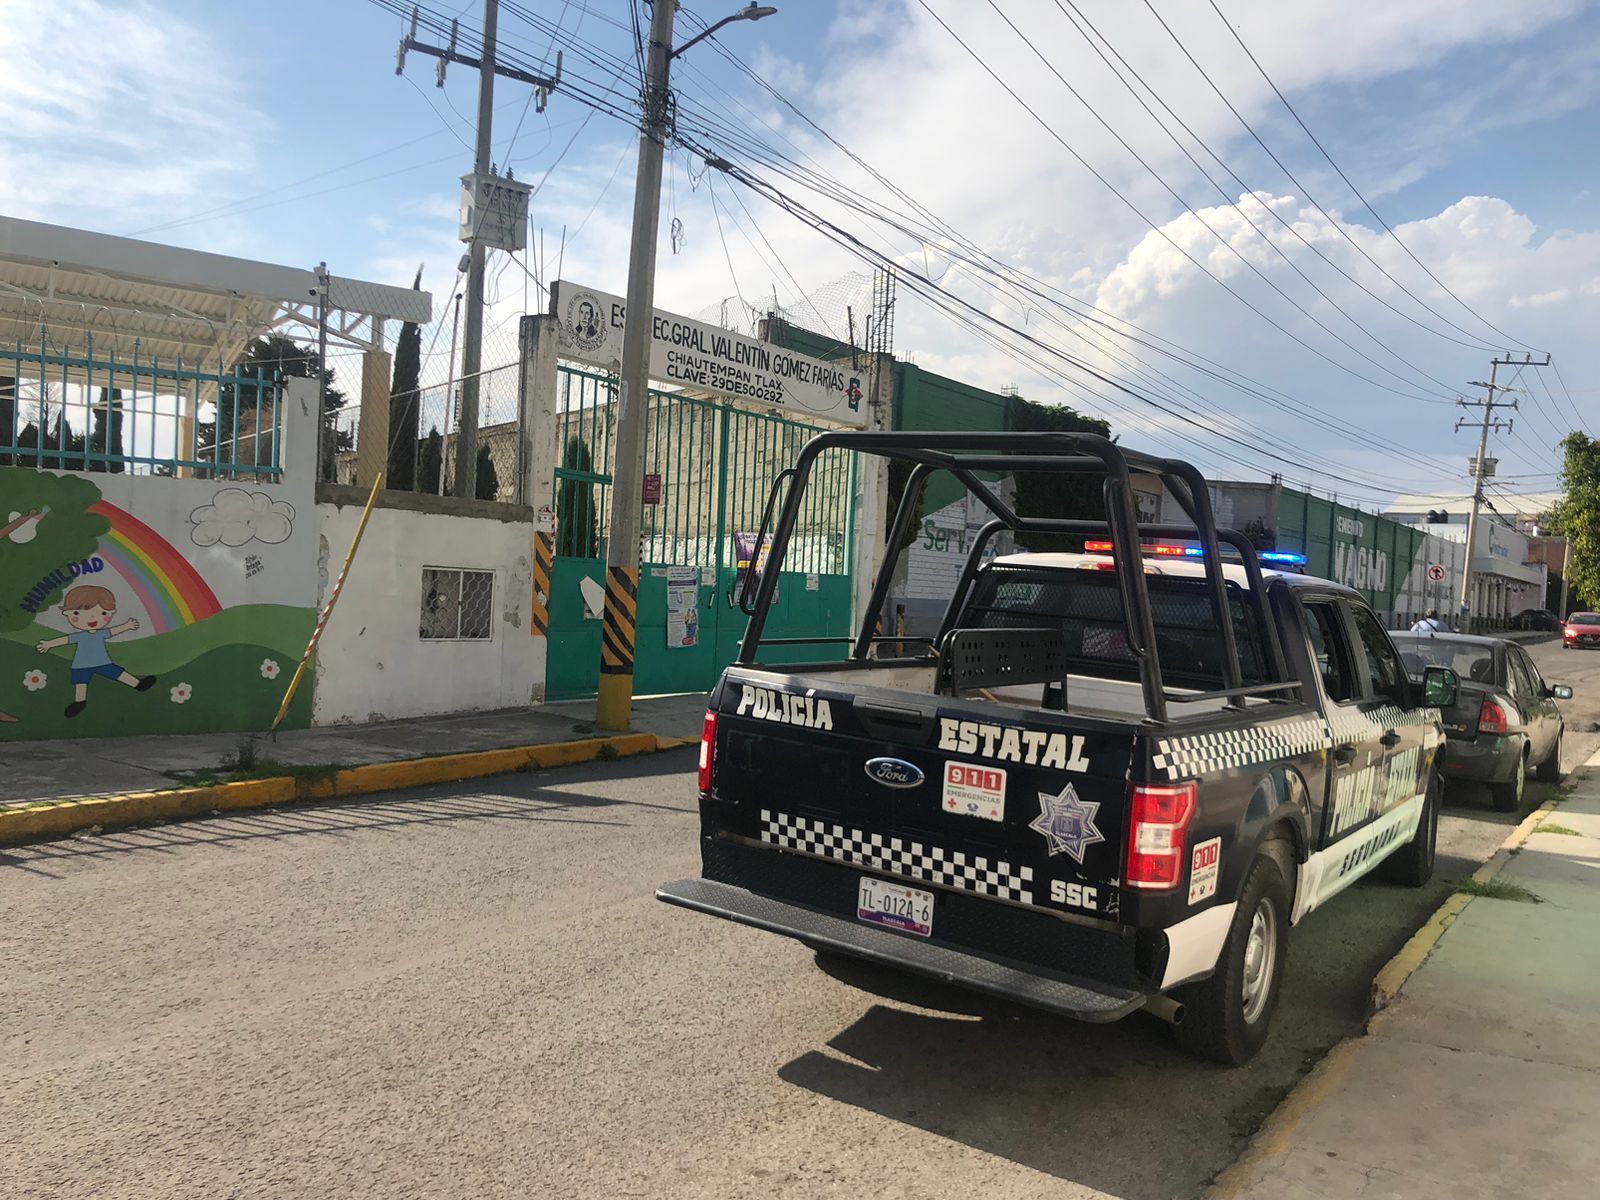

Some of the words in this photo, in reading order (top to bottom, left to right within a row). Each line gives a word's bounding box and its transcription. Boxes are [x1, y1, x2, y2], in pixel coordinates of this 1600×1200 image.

[667, 350, 751, 383] CHIAUTEMPAN
[755, 374, 785, 392] TLAX.
[773, 352, 811, 383] GÓMEZ
[812, 365, 844, 392] FARÍAS
[19, 556, 104, 613] HUMILDAD
[736, 684, 833, 731] POLICÍA
[938, 717, 1090, 773] ESTATAL
[876, 762, 908, 782] Ford
[951, 768, 997, 788] 911
[946, 789, 1001, 804] EMERGENCIAS
[1194, 845, 1217, 869] 911
[861, 888, 930, 922] TL-012A-6
[1050, 879, 1098, 910] SSC
